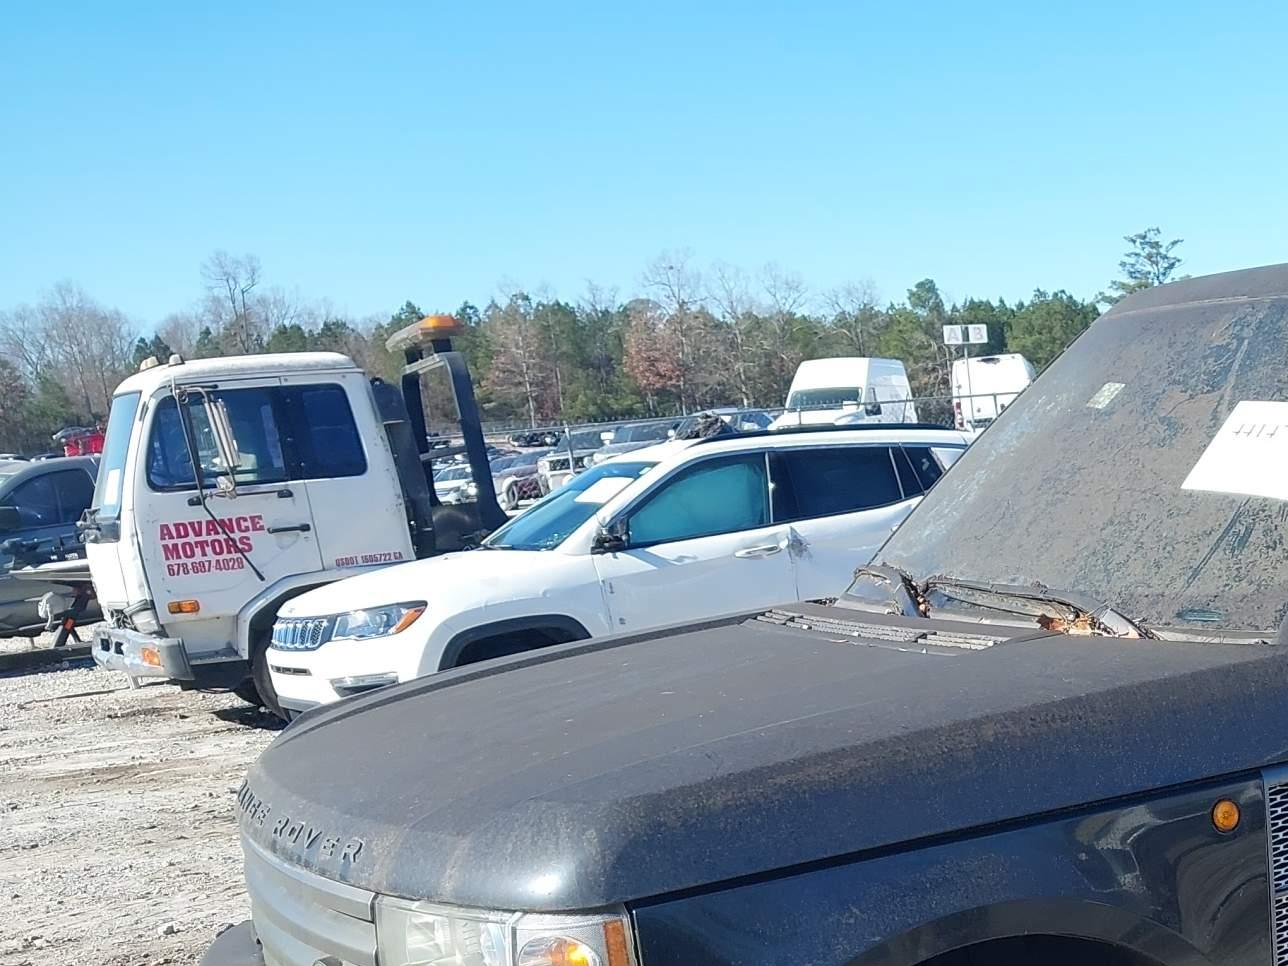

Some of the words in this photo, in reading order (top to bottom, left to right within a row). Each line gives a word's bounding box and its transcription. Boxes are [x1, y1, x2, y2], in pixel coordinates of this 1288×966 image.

[159, 514, 265, 541] ADVANCE
[162, 535, 253, 561] MOTORS
[272, 817, 364, 863] ROVER
